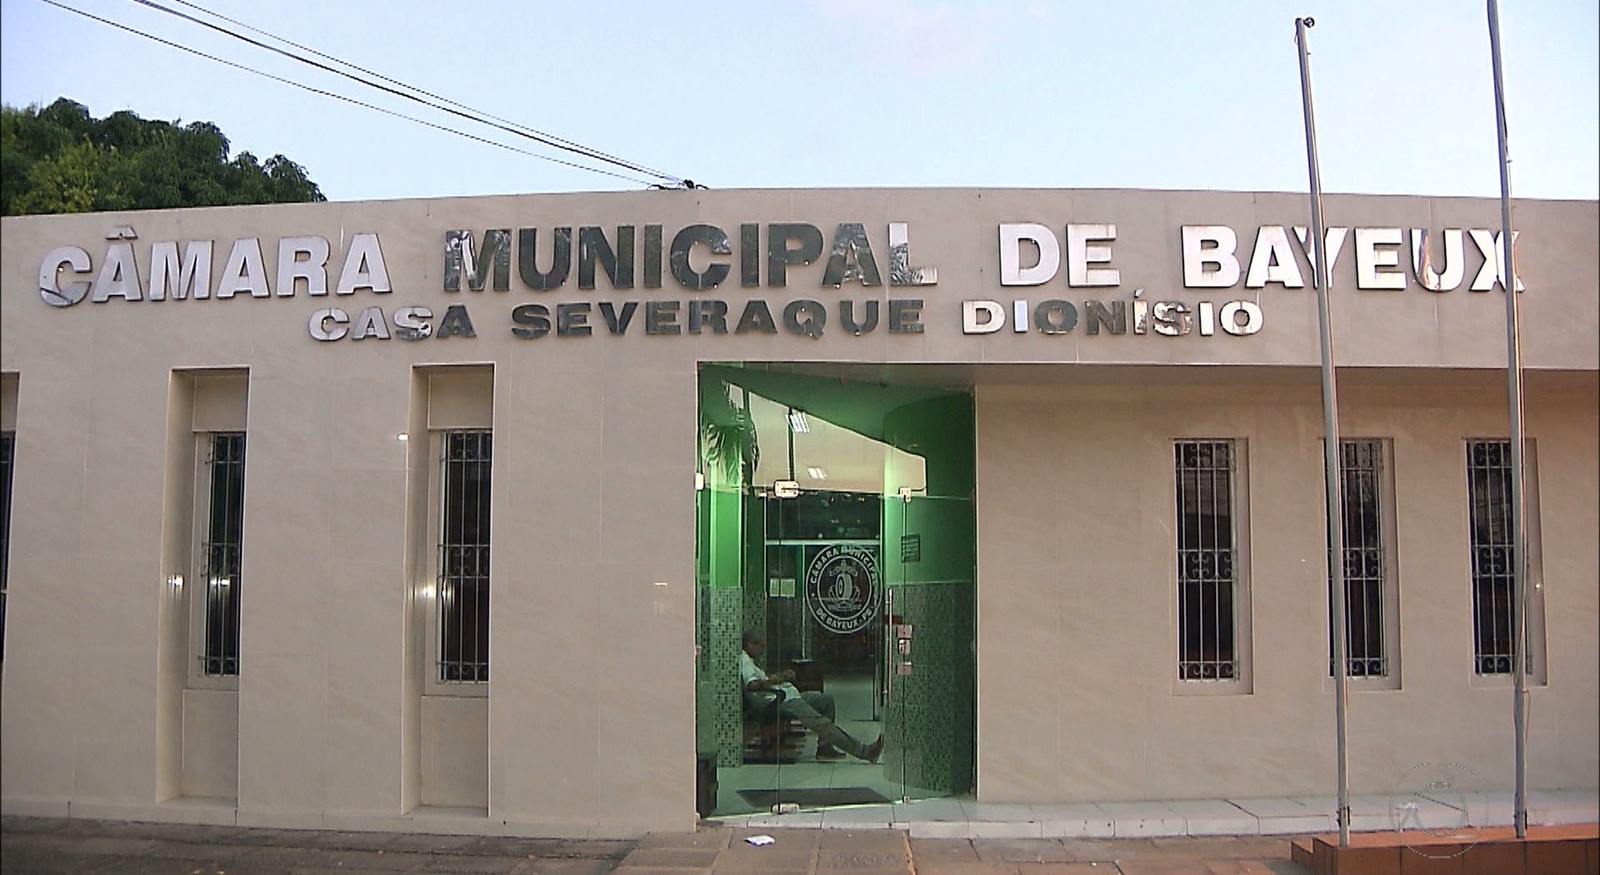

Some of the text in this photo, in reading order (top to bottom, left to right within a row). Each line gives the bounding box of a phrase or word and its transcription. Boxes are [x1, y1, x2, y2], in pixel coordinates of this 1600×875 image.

[38, 222, 1525, 306] CÂMARA MUNICIPAL DE BAYEUX
[308, 287, 1264, 342] CASA SEVERAQUE DIONÍSIO
[826, 617, 859, 629] BAYEUX
